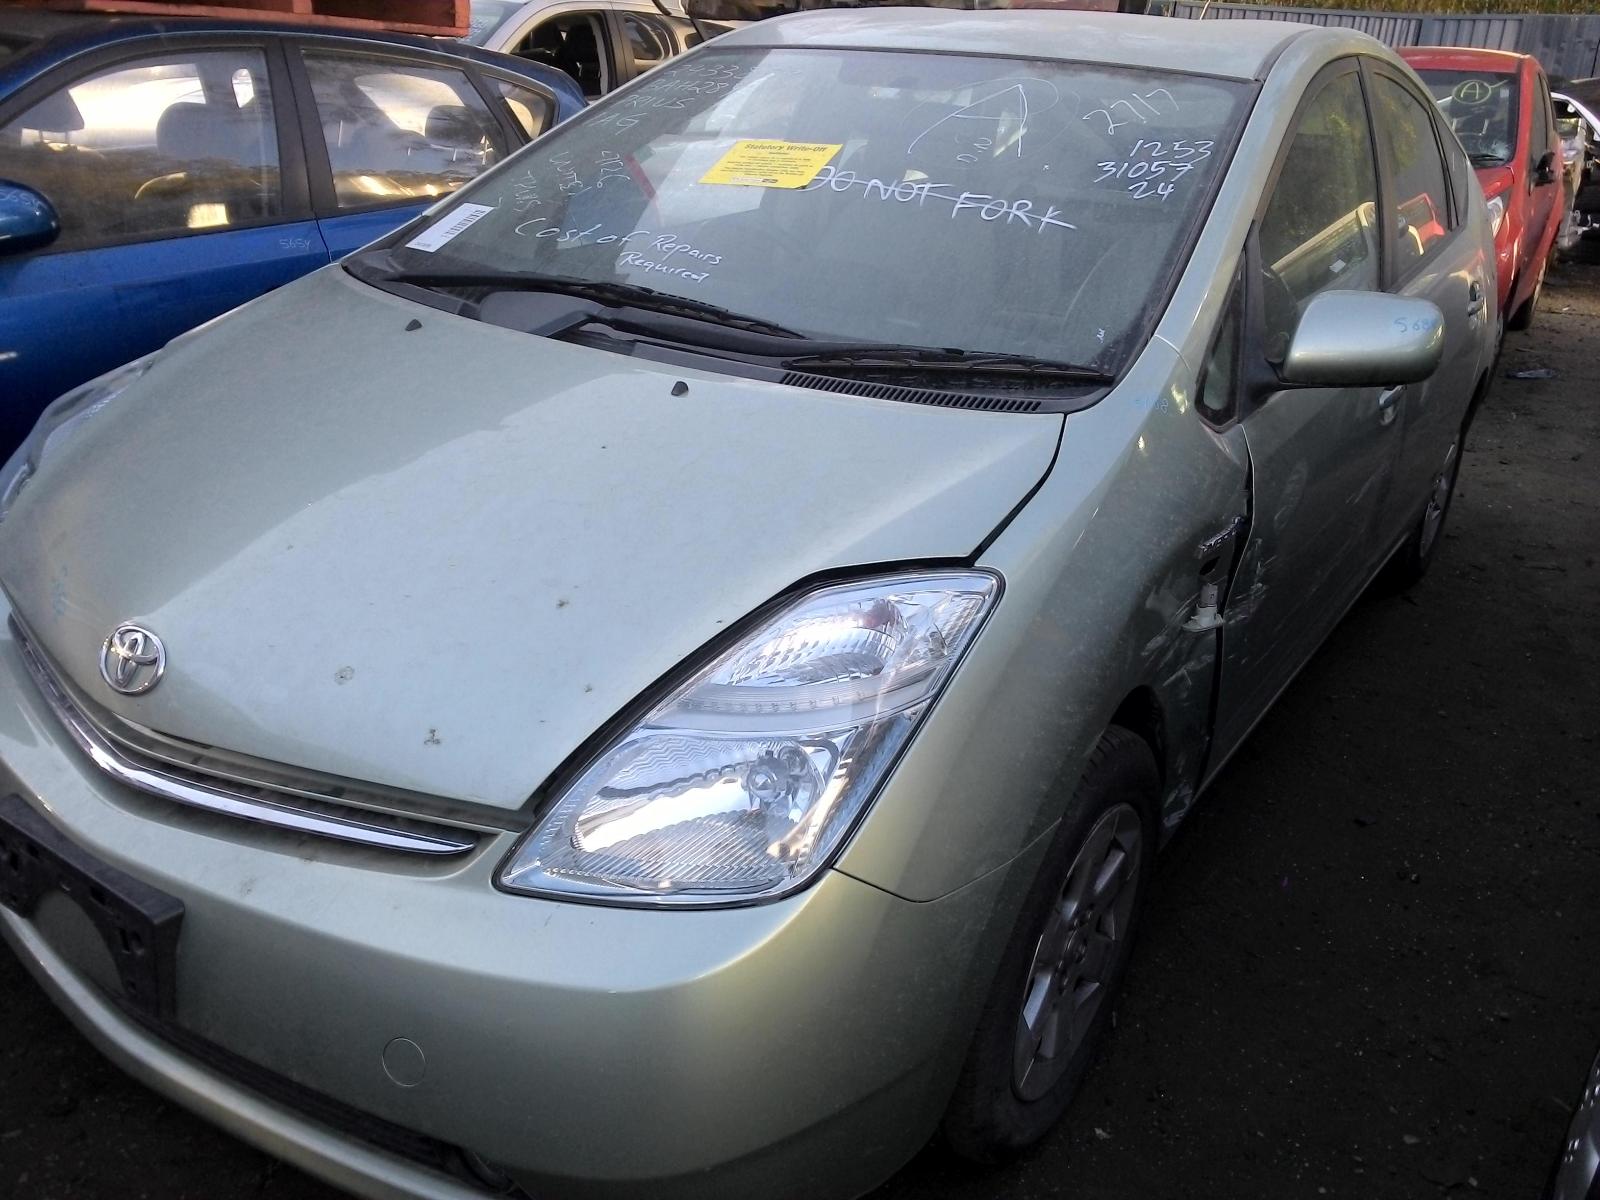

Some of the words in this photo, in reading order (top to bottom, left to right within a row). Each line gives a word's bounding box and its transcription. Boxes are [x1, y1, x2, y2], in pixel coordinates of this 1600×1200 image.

[1460, 81, 1480, 100] A
[1129, 139, 1215, 163] 1253
[1093, 160, 1195, 182] 31057
[1128, 181, 1175, 202] 24
[863, 177, 953, 207] NOT
[951, 191, 1078, 234] FORK
[515, 217, 602, 242] Cost
[650, 233, 723, 266] Repairs
[619, 251, 709, 284] Required
